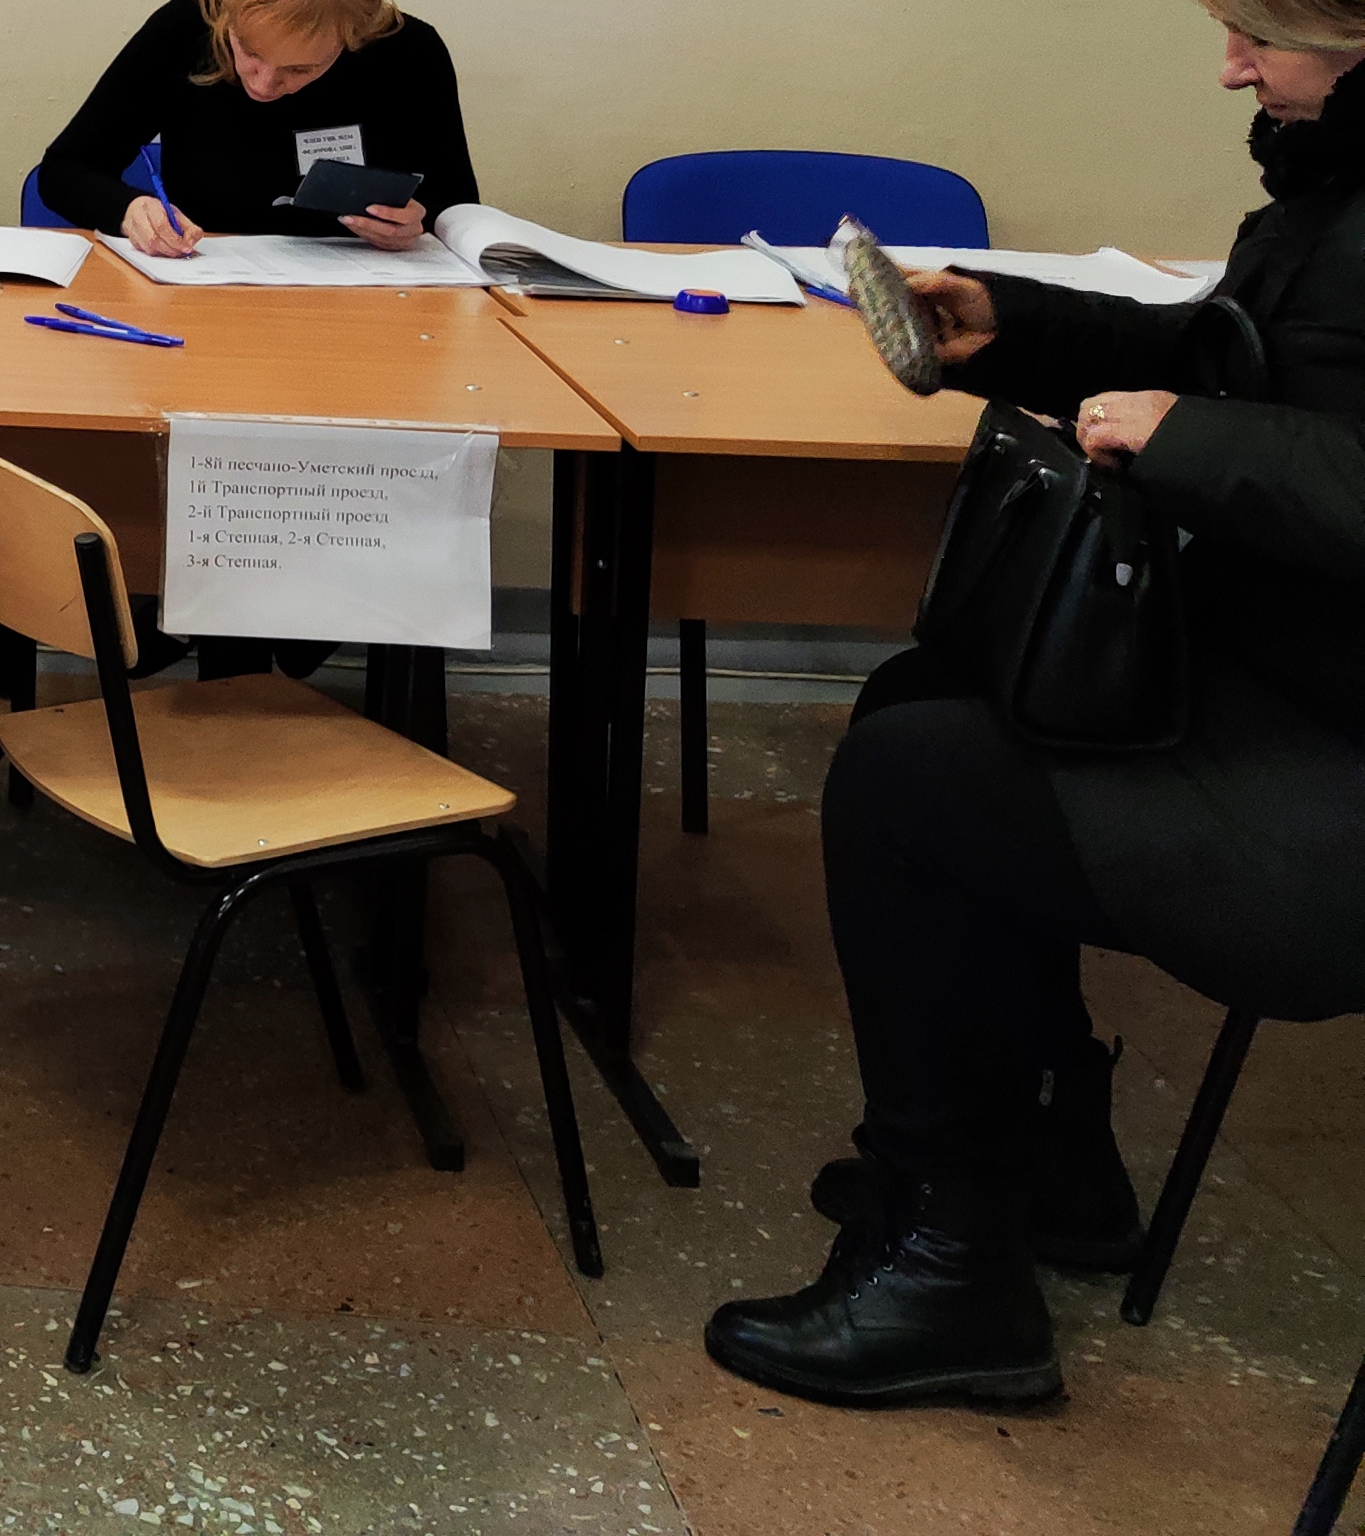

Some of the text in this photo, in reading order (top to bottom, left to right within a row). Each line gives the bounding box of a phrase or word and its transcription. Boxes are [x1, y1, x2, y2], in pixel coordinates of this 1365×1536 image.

[190, 456, 223, 470] 1-8й
[227, 460, 375, 476] песчано-Уметский
[189, 480, 389, 501] 1й Транспортный проезд,
[188, 505, 389, 525] 2-й Транспортный проезд
[189, 530, 386, 549] 1-я Степная, 2-я Степная,
[187, 554, 210, 567] 3-я
